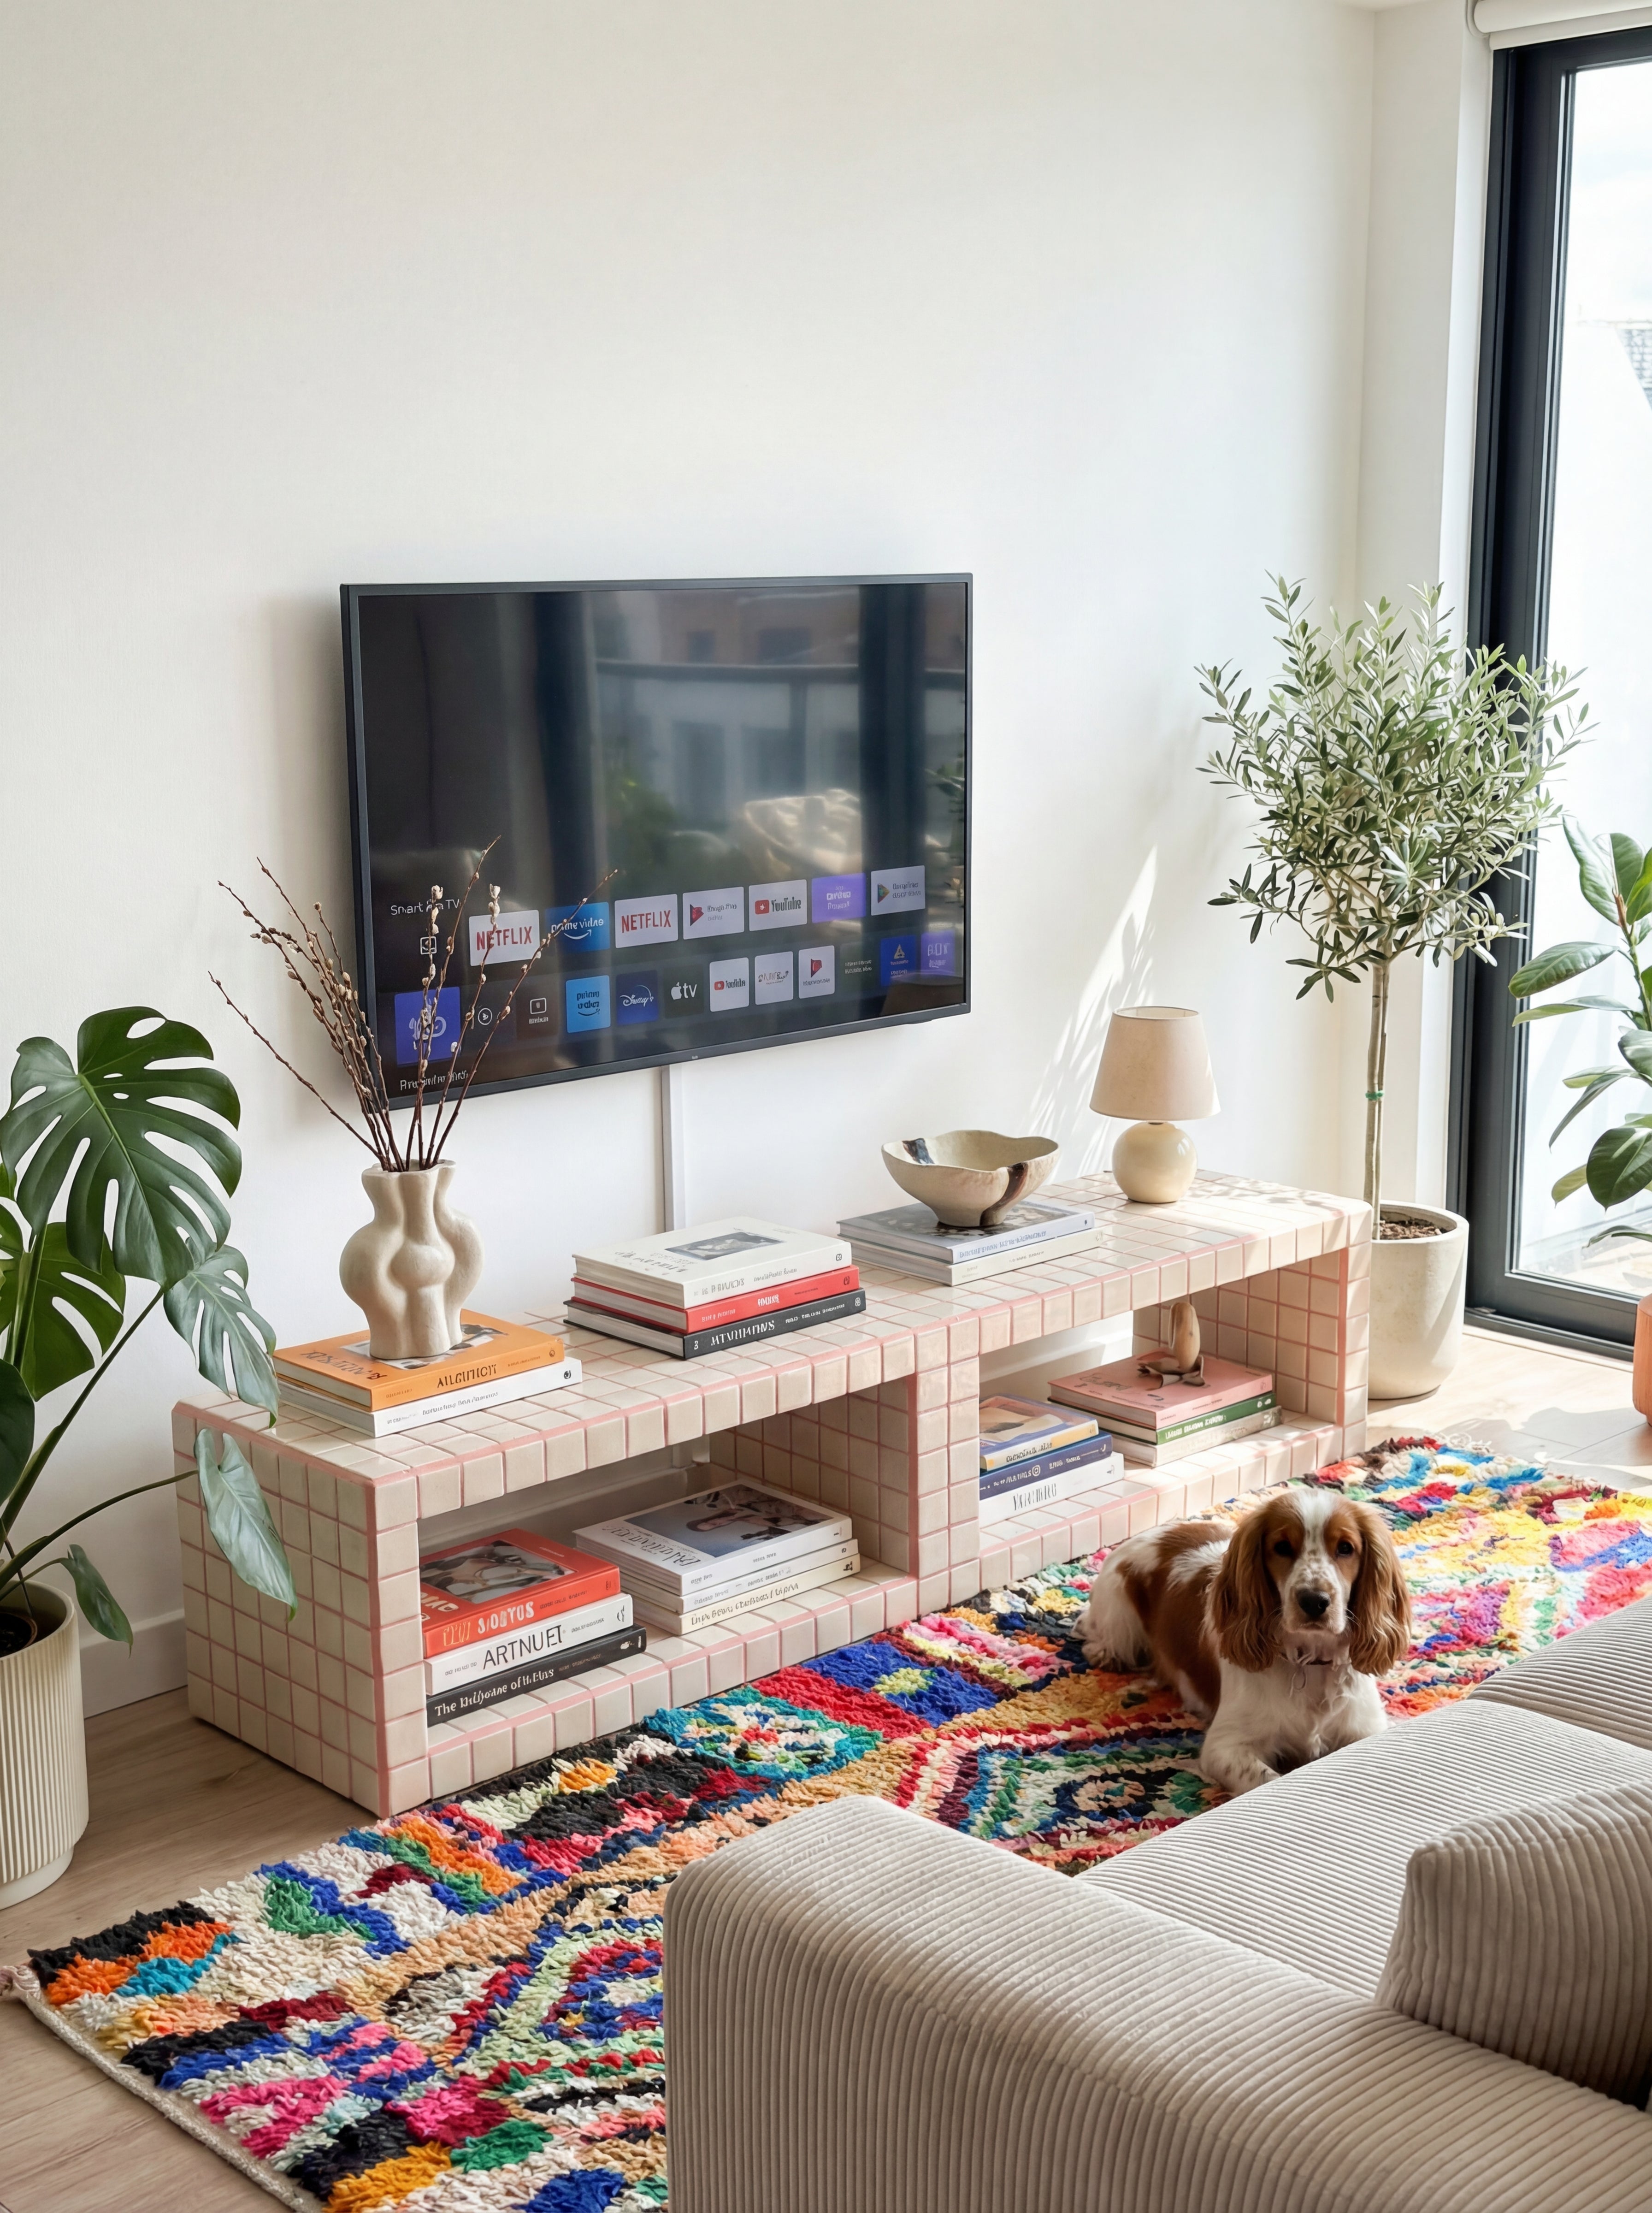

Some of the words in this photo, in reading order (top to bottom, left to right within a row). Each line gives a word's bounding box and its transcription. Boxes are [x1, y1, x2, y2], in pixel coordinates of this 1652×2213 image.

[391, 902, 423, 915] Smart
[445, 899, 460, 909] TV
[622, 910, 672, 934] NETFLIX
[477, 926, 532, 951] NETFLIX
[683, 982, 697, 999] tv
[435, 1702, 456, 1716] The
